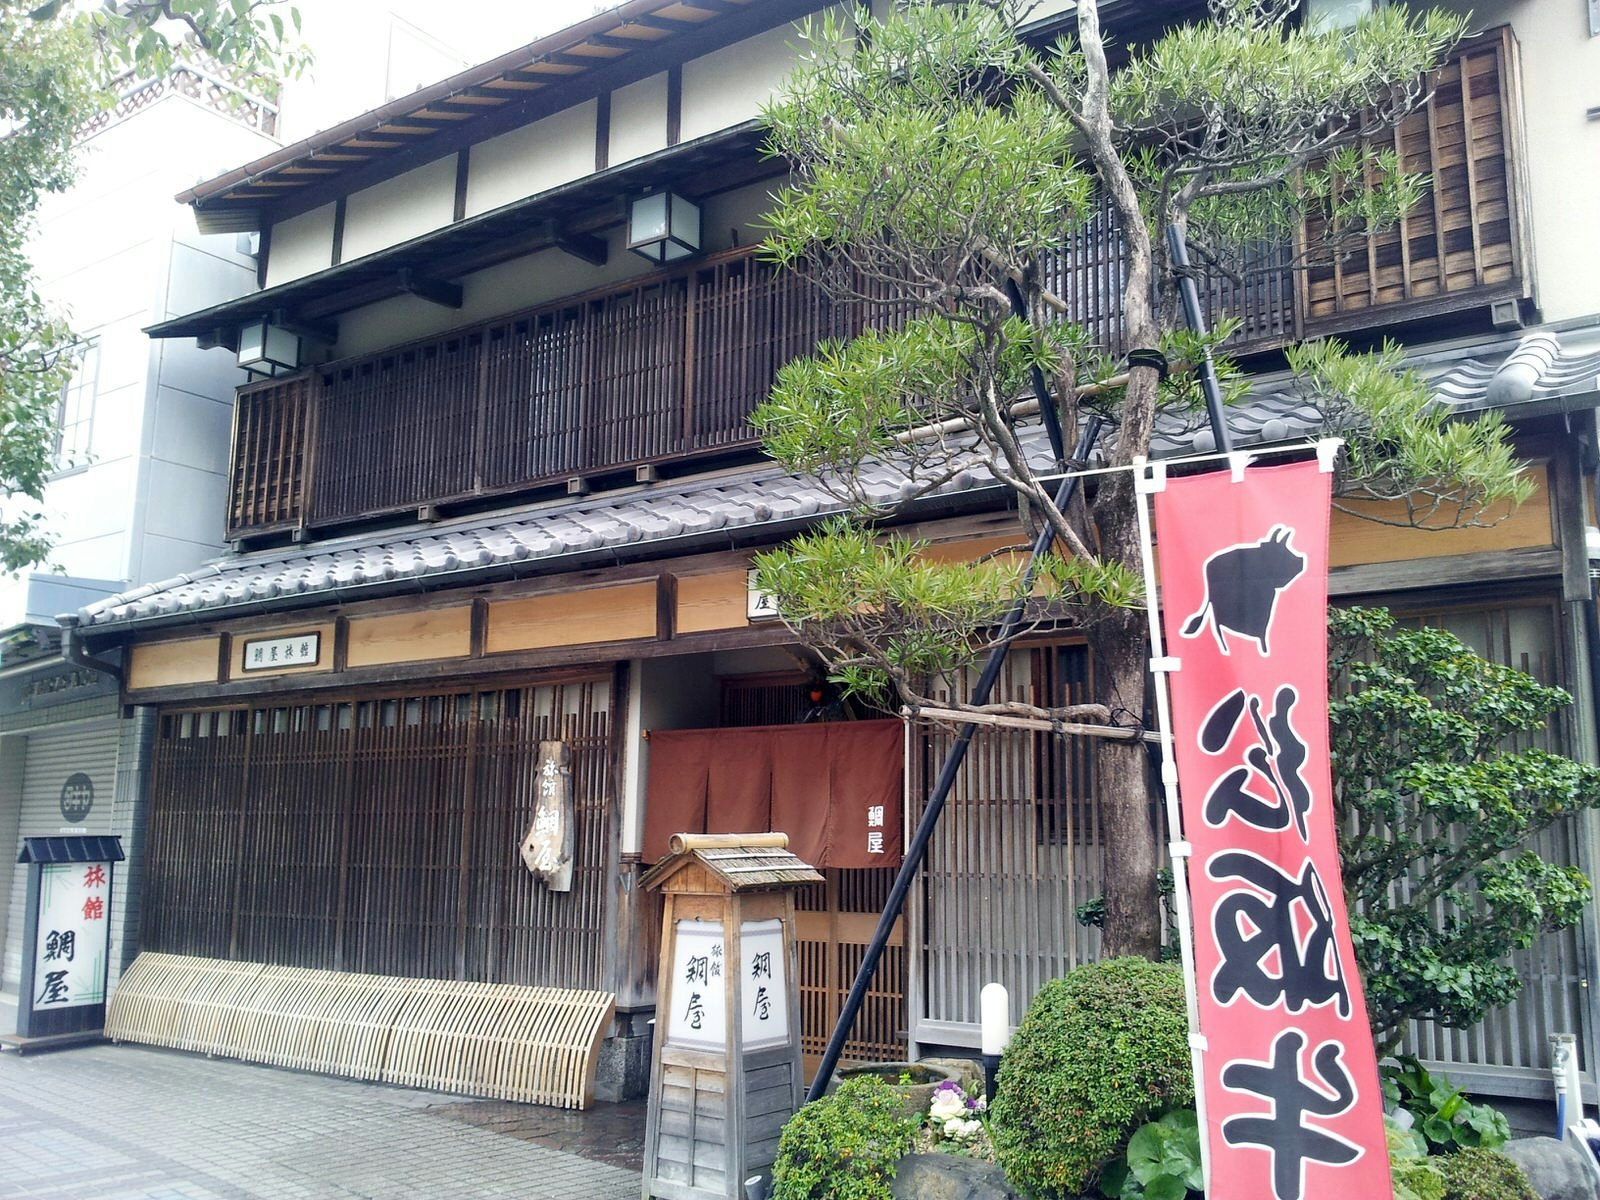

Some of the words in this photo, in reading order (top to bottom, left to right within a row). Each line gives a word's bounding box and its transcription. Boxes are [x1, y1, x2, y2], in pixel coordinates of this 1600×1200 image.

[253, 641, 310, 663] 鯛屋旅館
[867, 805, 885, 854] 鯛屋
[81, 863, 107, 921] 旅館
[35, 929, 76, 1005] 鯛屋
[709, 944, 723, 977] 旅館
[751, 951, 772, 1021] 鯛屋
[684, 954, 709, 1030] 鯛屋
